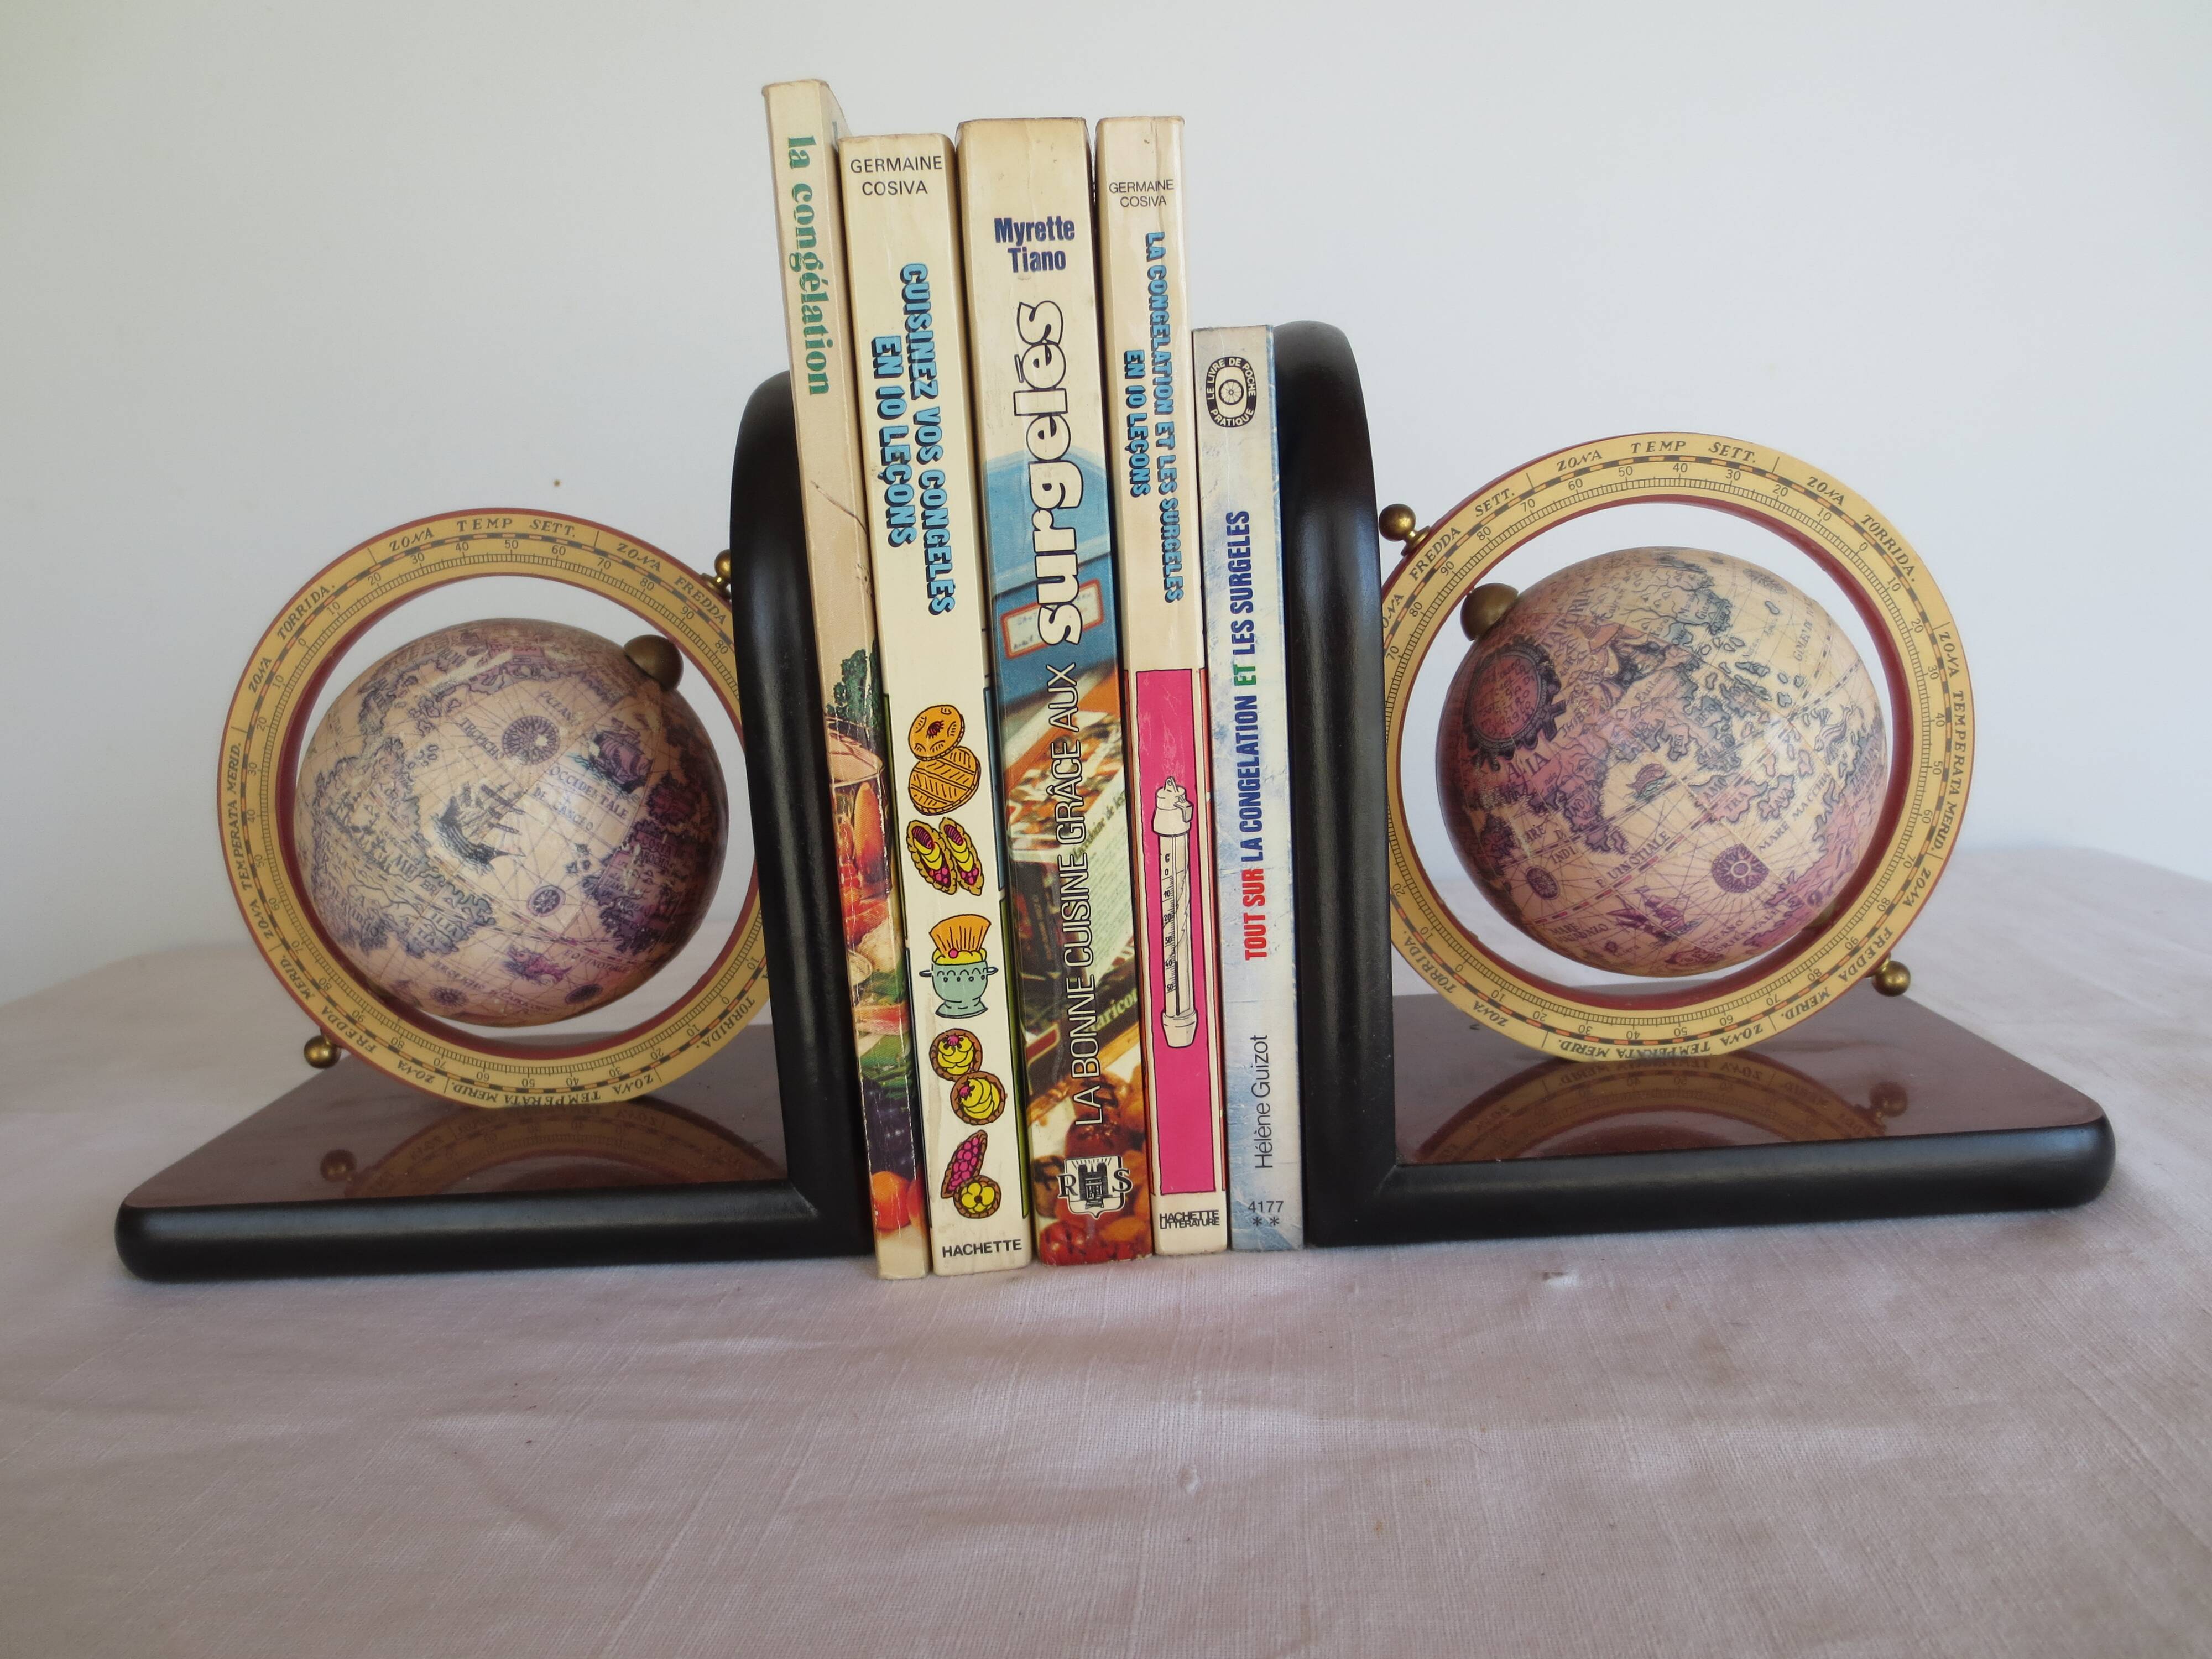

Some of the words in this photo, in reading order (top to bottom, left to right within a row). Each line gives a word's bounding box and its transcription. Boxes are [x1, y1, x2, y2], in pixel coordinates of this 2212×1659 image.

[786, 135, 817, 169] la
[849, 155, 943, 174] GERMAINE
[861, 179, 928, 196] COSIVA
[1108, 179, 1175, 194] GERMAINE
[1119, 195, 1167, 208] COSIVA
[994, 216, 1076, 244] Myrette
[1145, 231, 1166, 262] LA
[1006, 246, 1067, 274] Tiano
[787, 182, 831, 397] congélation
[900, 263, 938, 400] CUISINEZ
[1146, 265, 1175, 415] CONGELATION
[871, 336, 904, 379] EN
[1124, 350, 1145, 379] EN
[1229, 358, 1242, 367] DE
[1207, 359, 1225, 384] LIVRE
[1242, 363, 1256, 397] POCHE
[875, 386, 907, 420] 10
[1125, 385, 1147, 409] 10
[1207, 388, 1214, 400] LE
[1210, 408, 1254, 426] PRATIQUE
[913, 406, 943, 465] VOS
[1155, 421, 1176, 450] ET
[1125, 413, 1151, 498] LEÇONS
[1557, 450, 1603, 472] ZONA
[1630, 440, 1687, 454] TEMP
[1708, 441, 1757, 464] SETT.
[1013, 299, 1085, 646] surgelés
[1157, 455, 1178, 495] LES
[1618, 466, 1633, 477] 50
[1673, 463, 1688, 473] 40
[1725, 469, 1741, 481] 30
[878, 425, 917, 547] LEÇONS
[1568, 478, 1583, 490] 60
[1772, 484, 1788, 497] 20
[1520, 499, 1536, 512] 70
[1817, 507, 1832, 521] 10
[389, 527, 435, 552] ZONA
[456, 518, 513, 533] TEMP
[529, 518, 576, 538] SETT.
[1476, 526, 1492, 541] 80
[1806, 476, 1845, 506] ZONA
[1860, 514, 1917, 583] TORRIDA.
[455, 541, 469, 552] 40
[504, 539, 519, 550] 50
[551, 545, 566, 556] 60
[1159, 498, 1184, 604] SURGELES
[1859, 542, 1868, 551] 0
[410, 552, 425, 564] 30
[598, 557, 612, 570] 70
[1225, 510, 1254, 614] SURGELES
[1383, 592, 1405, 629] ONA
[1408, 526, 1462, 582] FREDDA
[1474, 488, 1516, 518] SETT.
[1440, 560, 1455, 576] 90
[367, 572, 382, 586] 20
[615, 542, 662, 572] ZONA
[673, 575, 727, 625] FREDDA
[640, 577, 655, 591] 80
[1887, 577, 1901, 592] 10
[326, 601, 341, 616] 10
[681, 606, 695, 620] 90
[1408, 602, 1423, 618] 80
[1911, 618, 1923, 633] 20
[248, 656, 272, 693] ZONA
[276, 584, 335, 640] TORRIDA.
[298, 638, 307, 648] 0
[714, 640, 729, 655] 80
[1230, 619, 1256, 656] LES
[1386, 645, 1400, 660] 70
[1939, 631, 1960, 678] ZONA
[272, 675, 285, 690] 10
[1233, 664, 1257, 687] ET
[1928, 665, 1939, 680] 30
[1046, 663, 1079, 732] AUX
[256, 716, 268, 732] 20
[1935, 713, 1945, 727] 40
[1948, 690, 1968, 796] TEMPERATA
[227, 742, 242, 796] MERID.
[248, 762, 258, 775] 30
[1234, 695, 1262, 832] CONGELATION
[1933, 761, 1942, 775] 50
[1050, 740, 1088, 848] GRÂCE
[247, 809, 257, 823] 40
[1921, 809, 1933, 824] 60
[1933, 804, 1957, 851] MERID.
[227, 799, 254, 892] TEMPERATA
[1241, 838, 1264, 862] LA
[1903, 854, 1916, 869] 70
[1242, 868, 1265, 906] SUR
[1392, 883, 1407, 897] 20
[1903, 866, 1932, 908] ZONA
[1058, 852, 1095, 967] CUISINE
[1877, 898, 1891, 912] 80
[249, 898, 274, 940] ZONA
[1165, 936, 1172, 944] 30
[1244, 912, 1267, 961] TOUT
[1420, 926, 1434, 940] 10
[1845, 937, 1859, 951] 90
[1402, 930, 1457, 994] TORRIDA.
[1838, 926, 1894, 983] FREDDA
[253, 854, 263, 868] 50
[268, 898, 280, 910] 60
[291, 940, 305, 954] 70
[318, 977, 333, 992] 80
[351, 1009, 365, 1023] 90
[390, 1036, 406, 1050] 80
[433, 1057, 447, 1069] 70
[476, 1071, 490, 1082] 60
[521, 1078, 535, 1088] 50
[566, 1077, 580, 1087] 40
[609, 1066, 623, 1077] 30
[650, 1047, 665, 1060] 20
[686, 1024, 701, 1037] 10
[721, 995, 730, 1005] 0
[746, 956, 760, 970] 10
[279, 954, 316, 1001] MERID.
[1454, 963, 1463, 973] 0
[1807, 968, 1822, 982] 80
[1490, 989, 1506, 1002] 10
[1766, 993, 1781, 1006] 70
[1781, 985, 1831, 1021] MERID.
[695, 997, 755, 1050] TORRIDA.
[1471, 1000, 1509, 1027] ZONA
[1532, 1010, 1548, 1022] 20
[1719, 1015, 1734, 1026] 60
[321, 1005, 378, 1054] FREDDA
[1066, 973, 1100, 1079] BONNE
[1578, 1024, 1593, 1036] 30
[1625, 1029, 1641, 1040] 40
[1673, 1027, 1688, 1037] 50
[1720, 1022, 1764, 1047] ZONA
[1558, 1039, 1613, 1058] MERID.
[1616, 1040, 1712, 1060] TEMPERATA
[397, 1059, 436, 1084] ZONA
[1251, 1034, 1272, 1099] Guizot
[452, 1078, 498, 1103] MERID.
[612, 1072, 654, 1095] ZONA
[503, 1091, 601, 1106] TEMPERATA
[1073, 1084, 1104, 1128] LA
[1253, 1103, 1274, 1170] Hélène
[1159, 1209, 1219, 1222] HACHETTE
[1248, 1201, 1284, 1213] 4177
[941, 1238, 1023, 1259] HACHETTE
